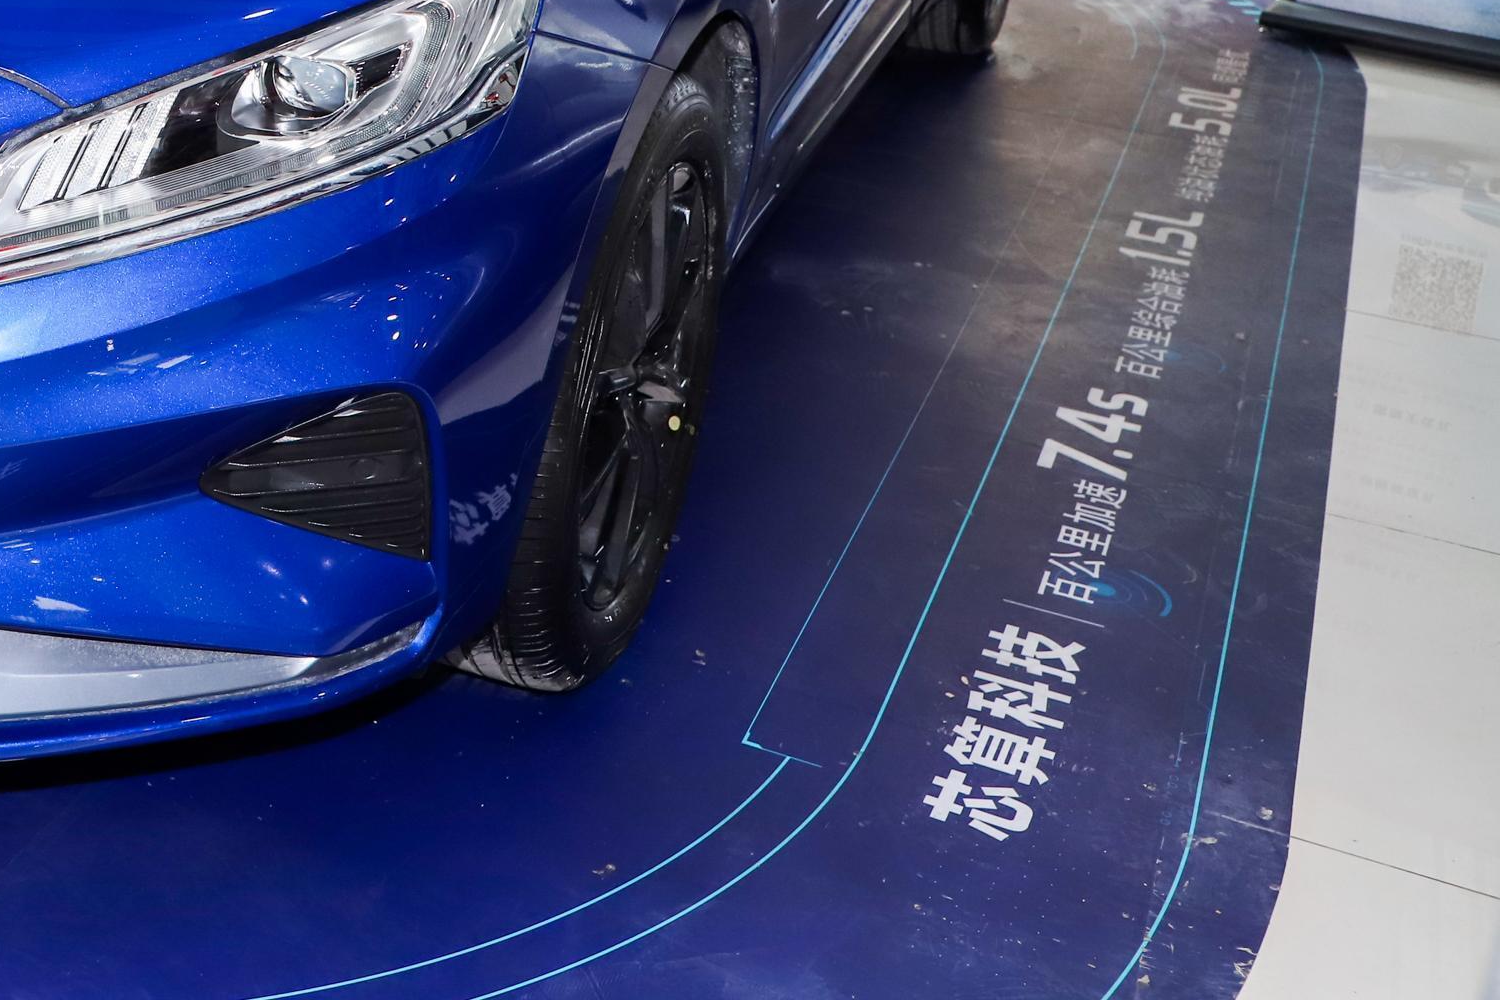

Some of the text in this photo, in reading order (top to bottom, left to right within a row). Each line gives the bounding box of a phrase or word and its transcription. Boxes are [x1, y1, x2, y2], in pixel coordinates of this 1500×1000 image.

[1168, 87, 1242, 136] 5.0L
[1119, 211, 1204, 266] 1.5L
[1115, 266, 1190, 379] 百公里综合油耗
[1037, 479, 1127, 604] 百公里加速
[923, 624, 1086, 841] 芯算科技
